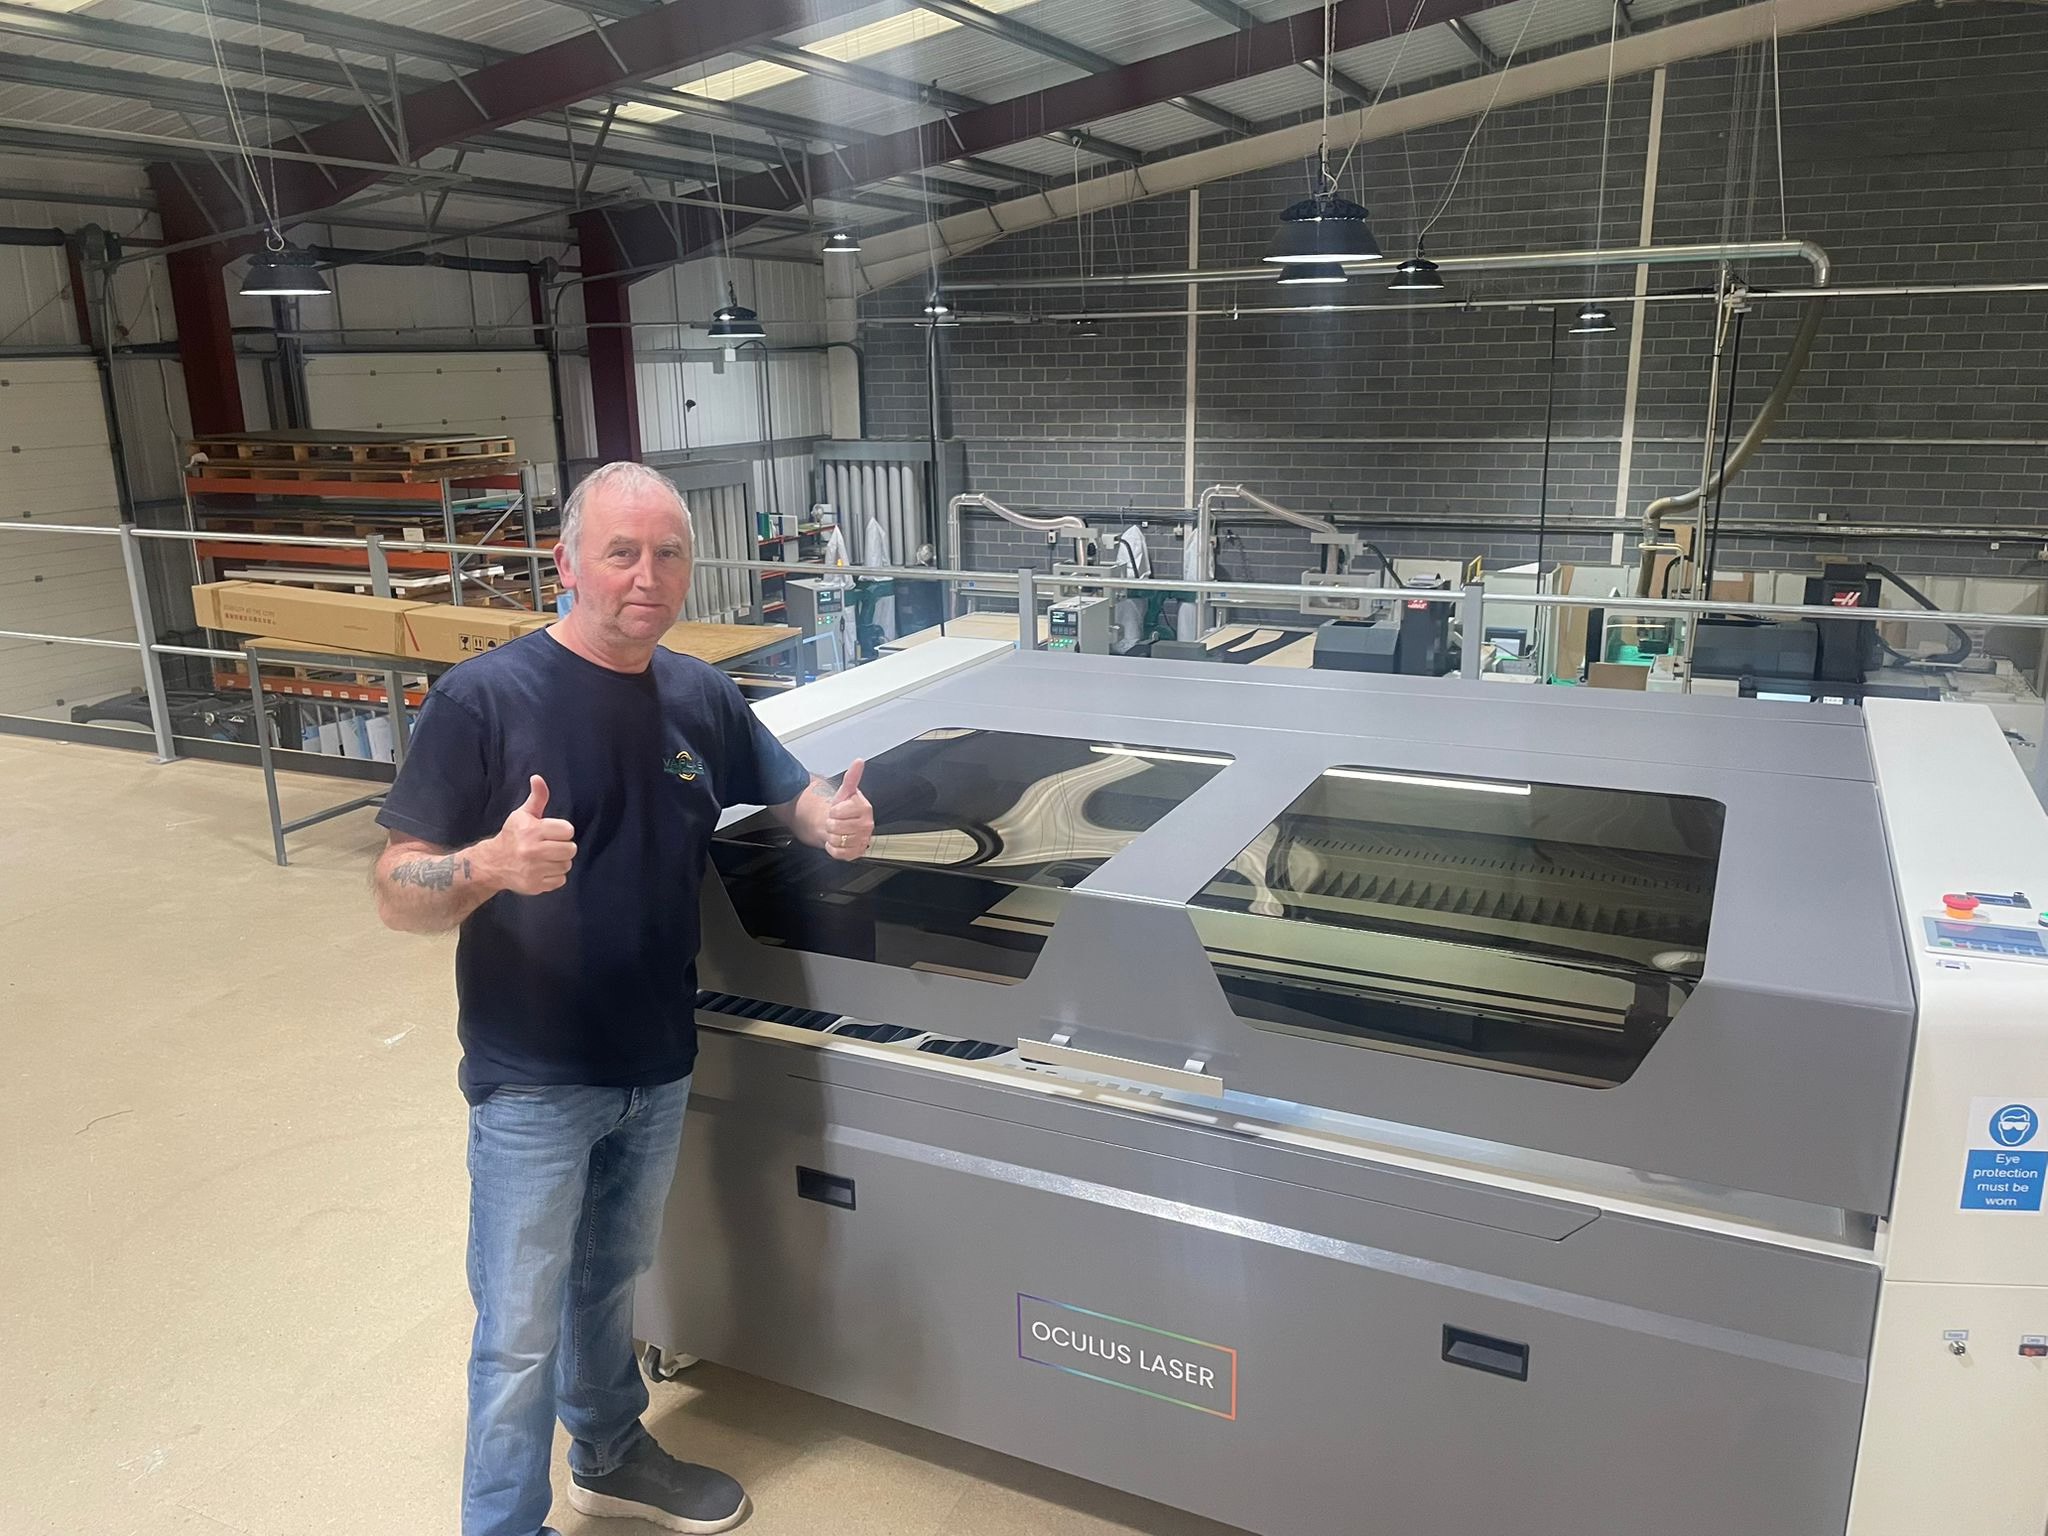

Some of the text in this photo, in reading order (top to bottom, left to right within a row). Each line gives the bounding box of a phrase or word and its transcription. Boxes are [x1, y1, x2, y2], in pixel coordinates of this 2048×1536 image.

[1996, 1153, 2021, 1166] Eye
[1973, 1168, 2038, 1179] protection
[1977, 1182, 2029, 1193] must be
[1985, 1197, 2017, 1206] worn
[1031, 1321, 1215, 1389] OCULUS LASER
